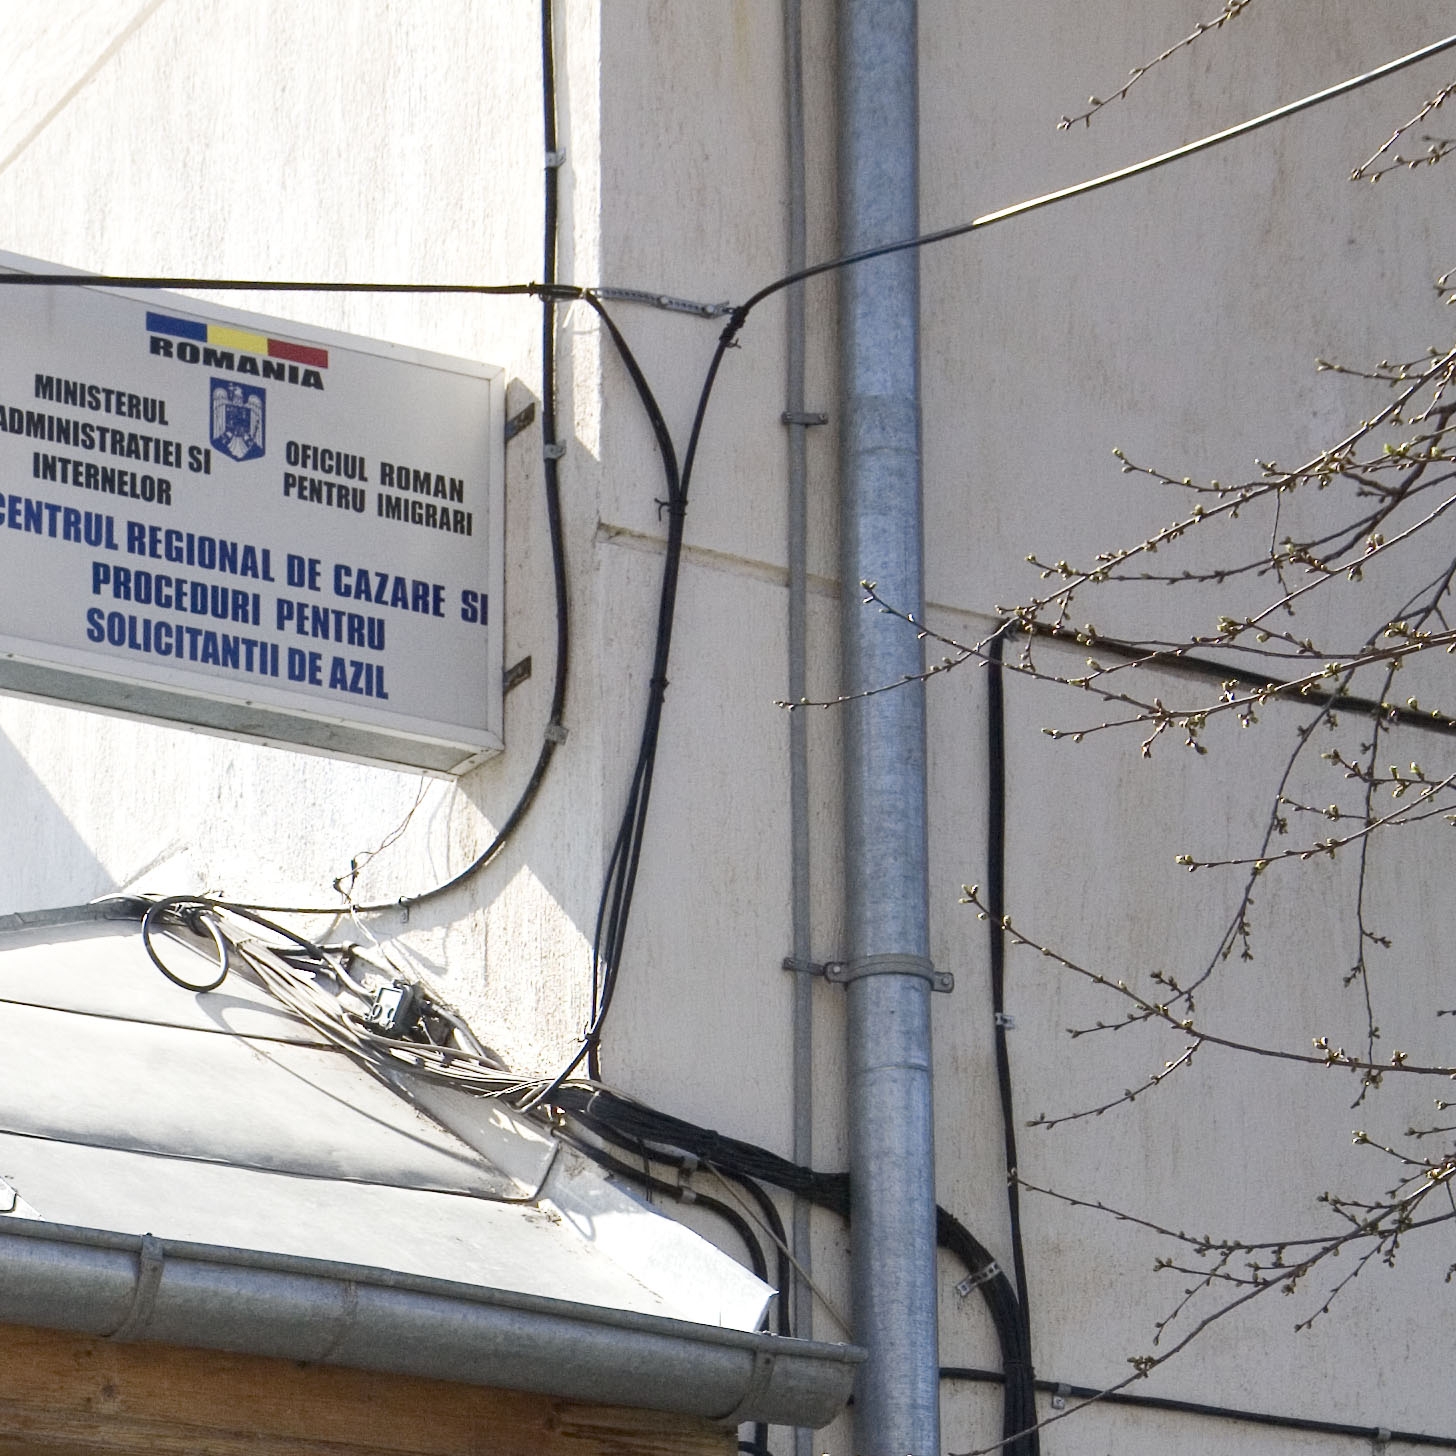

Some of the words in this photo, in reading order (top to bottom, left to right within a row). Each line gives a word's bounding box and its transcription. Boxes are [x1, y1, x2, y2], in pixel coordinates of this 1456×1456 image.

[150, 336, 324, 390] ROMANIA
[35, 374, 168, 426] MINISTERUL
[33, 452, 172, 506] INTERNELOR
[188, 445, 211, 475] SI
[286, 440, 368, 482] OFICIUL
[380, 461, 464, 503] ROMAN
[283, 472, 366, 513] PENTRU
[377, 493, 473, 536] IMIGRARI
[126, 520, 275, 582] REGIONAL
[286, 553, 321, 592] DE
[333, 563, 445, 618] CAZARE
[461, 589, 488, 626] SI
[92, 561, 261, 626] PROCEDURI
[276, 598, 385, 651] PENTRU
[86, 607, 279, 677] SOLICITANTII
[287, 647, 322, 687] DE
[328, 656, 389, 700] AZIL
